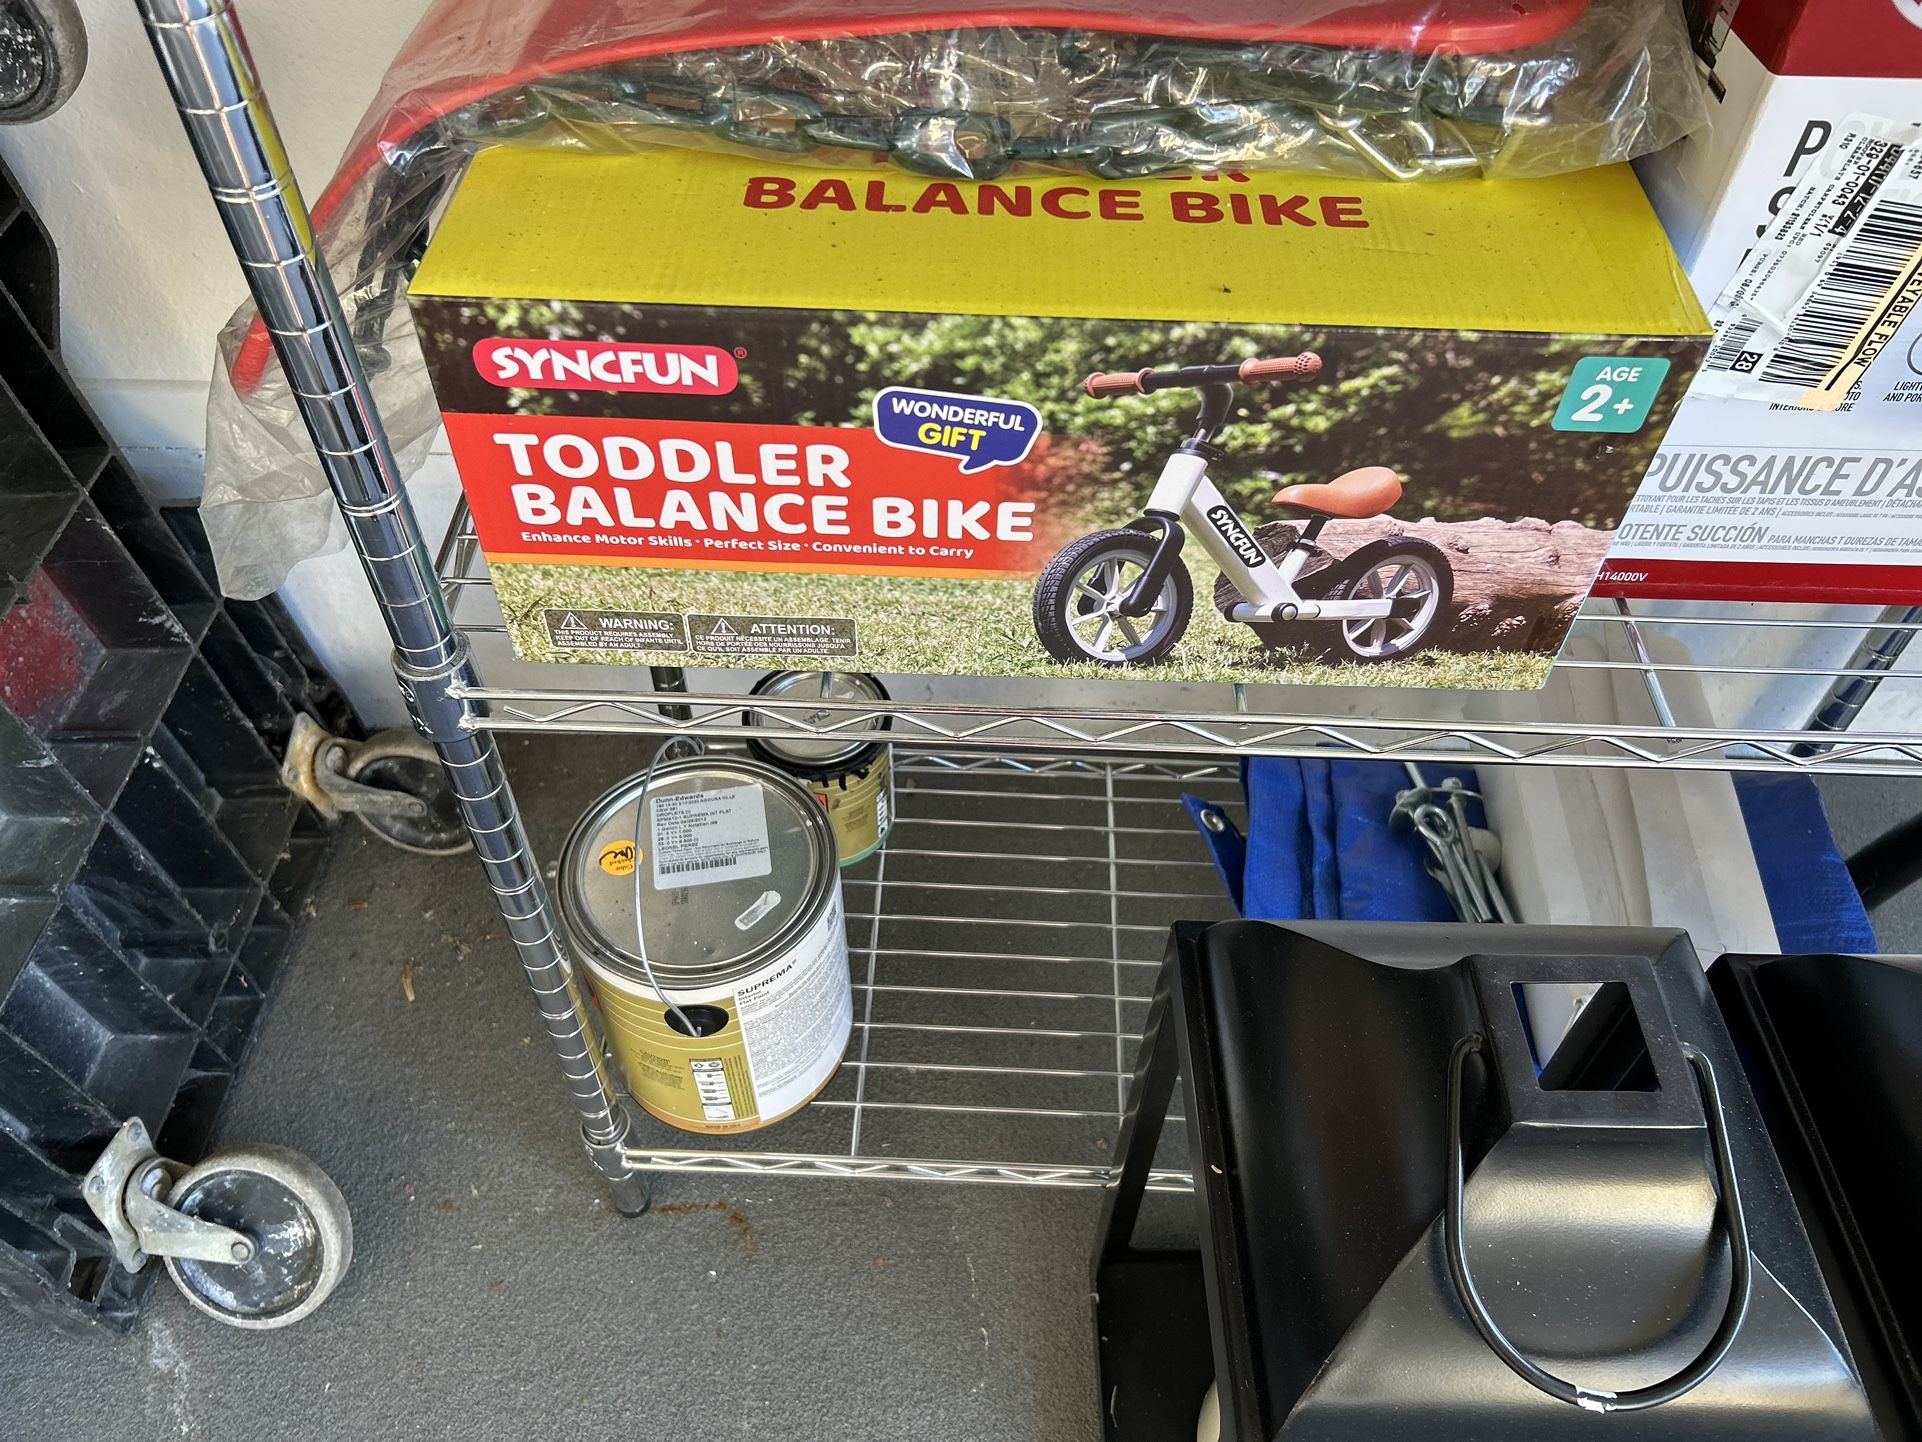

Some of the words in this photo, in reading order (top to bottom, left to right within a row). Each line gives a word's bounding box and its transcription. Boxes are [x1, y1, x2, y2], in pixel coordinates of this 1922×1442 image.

[742, 176, 1145, 222] BALANCE
[1170, 191, 1370, 230] BIKE
[1880, 271, 1922, 328] EYABLE
[1735, 353, 1758, 370] 28
[1854, 332, 1890, 367] FLOW
[491, 346, 719, 388] SYNCFUN
[1595, 366, 1643, 382] AGE
[1570, 384, 1634, 422] 2+
[1883, 393, 1904, 402] AND
[892, 397, 1025, 432] WONDERFUL
[918, 422, 987, 451] GIFT
[493, 433, 852, 488] TODDLER
[1647, 453, 1862, 496] PUISSANCE
[510, 483, 851, 535] BALANCE
[872, 497, 1036, 541] BIKE
[1666, 495, 1686, 503] POUR
[1741, 497, 1755, 505] LES
[1757, 497, 1775, 505] TAPIS
[1785, 498, 1799, 506] LES
[1800, 498, 1824, 506] TISSUS
[1666, 505, 1704, 514] GARANTIE
[1705, 505, 1738, 515] LIMITÉE
[1739, 506, 1751, 515] DE
[1751, 507, 1759, 515] 2
[1758, 507, 1777, 515] ANS
[521, 531, 592, 544] Enhance
[595, 533, 645, 546] Motor
[648, 535, 693, 547] Skills
[704, 537, 764, 550] Perfect
[768, 540, 801, 552] Size
[812, 541, 905, 556] Convenient
[908, 545, 926, 556] to
[929, 546, 974, 559] Carry
[1211, 510, 1262, 565] SYNCFUN
[1687, 522, 1769, 543] SUCCIÓN
[1767, 534, 1792, 543] PARA
[1792, 535, 1837, 545] MANCHAS
[1843, 537, 1885, 545] DUREZAS
[1884, 537, 1899, 546] DE
[598, 617, 674, 631] WARNING:
[751, 623, 835, 636] ATTENTION:
[656, 793, 704, 804] Dunn-Edwards
[737, 965, 793, 998] SUPREMA
